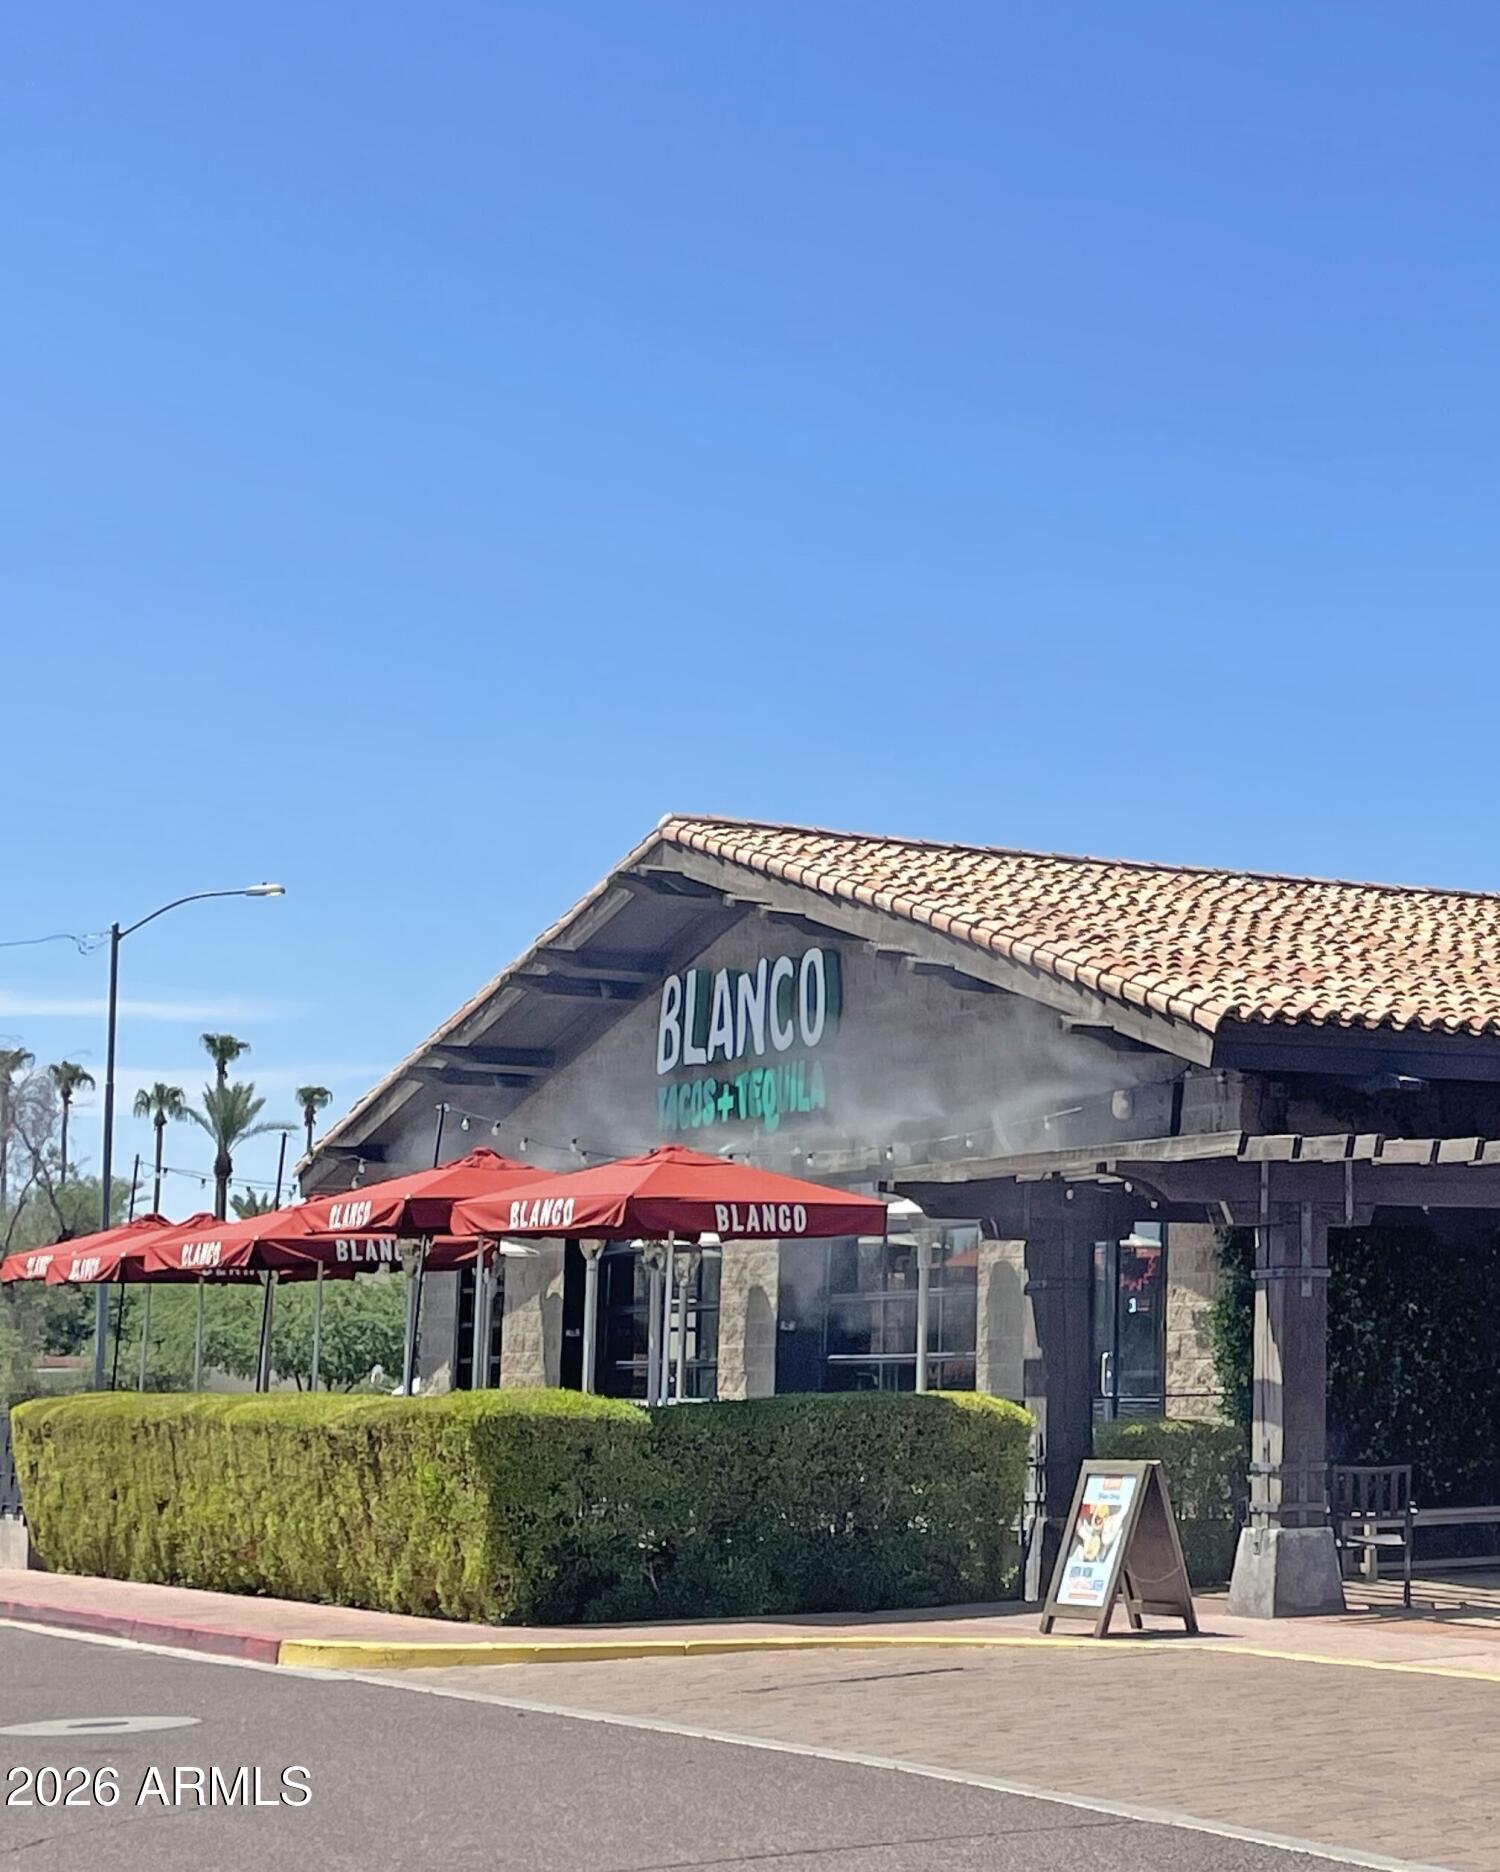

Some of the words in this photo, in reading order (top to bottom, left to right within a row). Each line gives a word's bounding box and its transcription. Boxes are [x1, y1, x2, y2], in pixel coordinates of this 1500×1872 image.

[657, 948, 826, 1075] BLANCO
[329, 1201, 371, 1229] BLANCO
[509, 1198, 575, 1230] BLANCO
[715, 1204, 807, 1233] BLANCO
